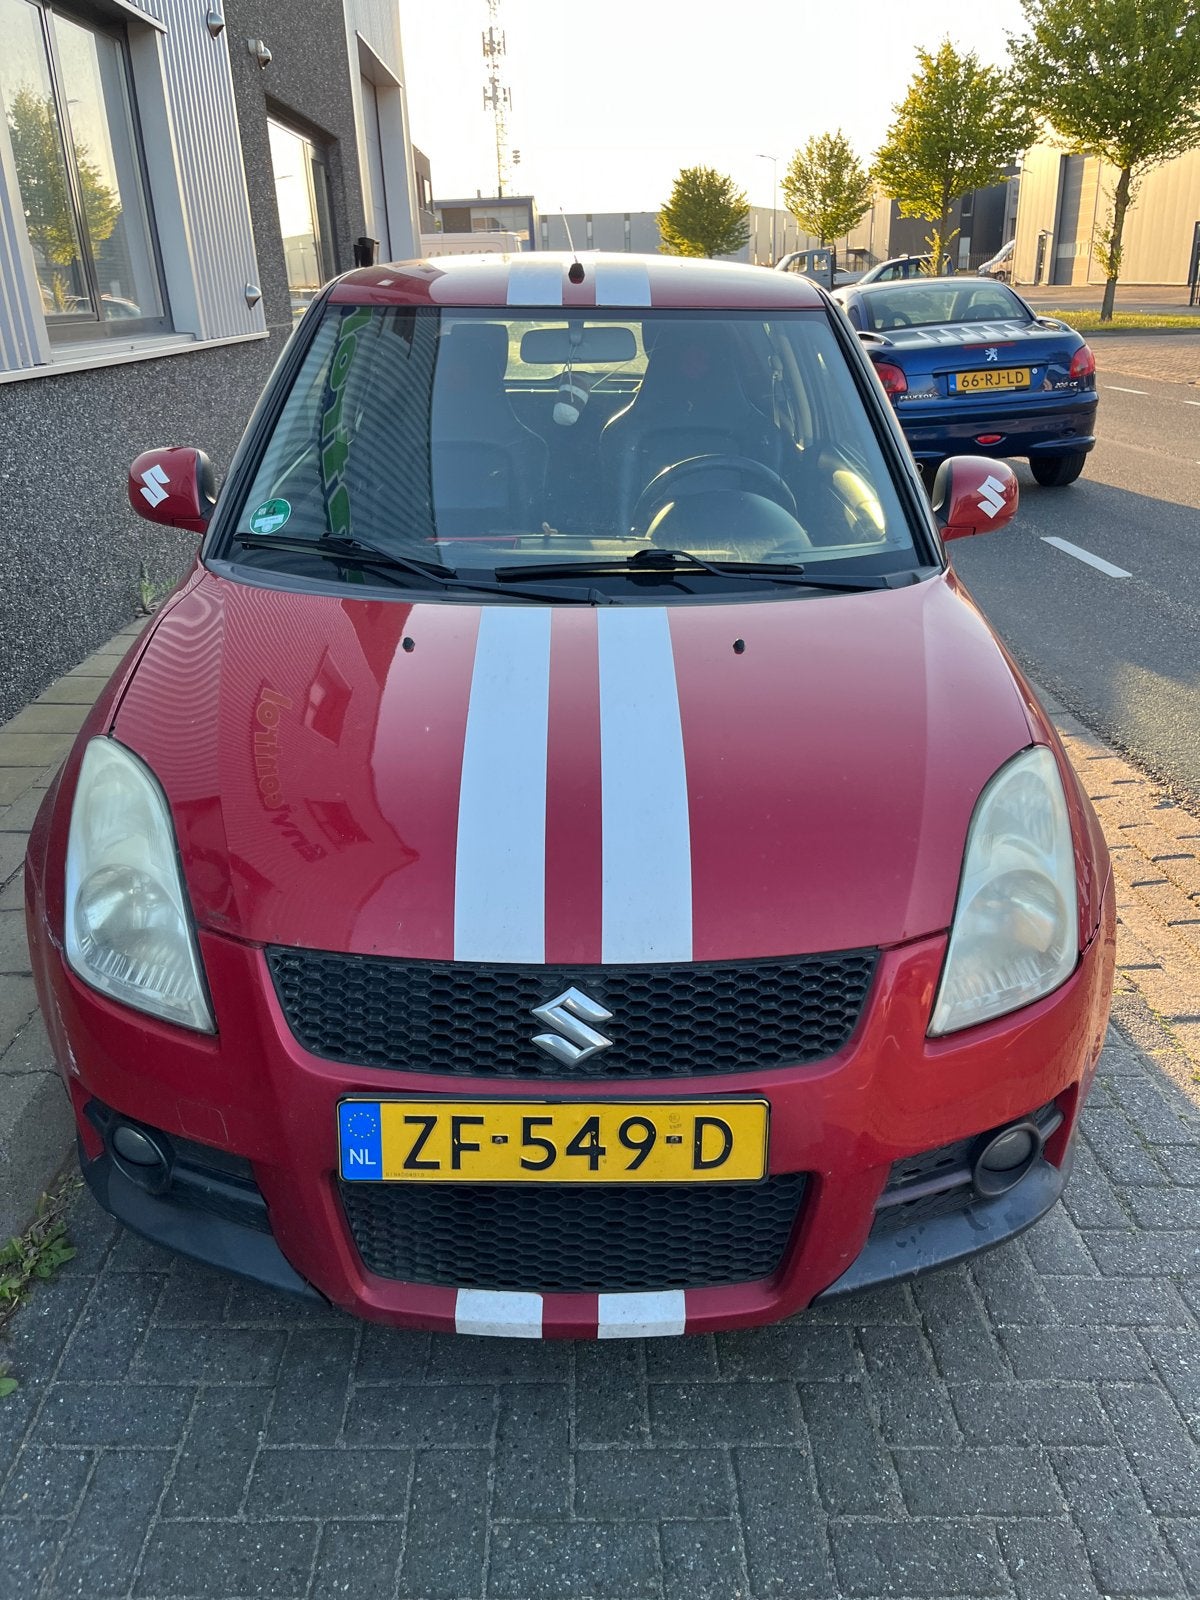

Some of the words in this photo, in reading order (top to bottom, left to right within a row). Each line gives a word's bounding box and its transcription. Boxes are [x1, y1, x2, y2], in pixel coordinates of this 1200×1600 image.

[961, 371, 1024, 388] 66-RJ-LD
[402, 1114, 734, 1171] ZF-549-D
[349, 1149, 377, 1166] NL
